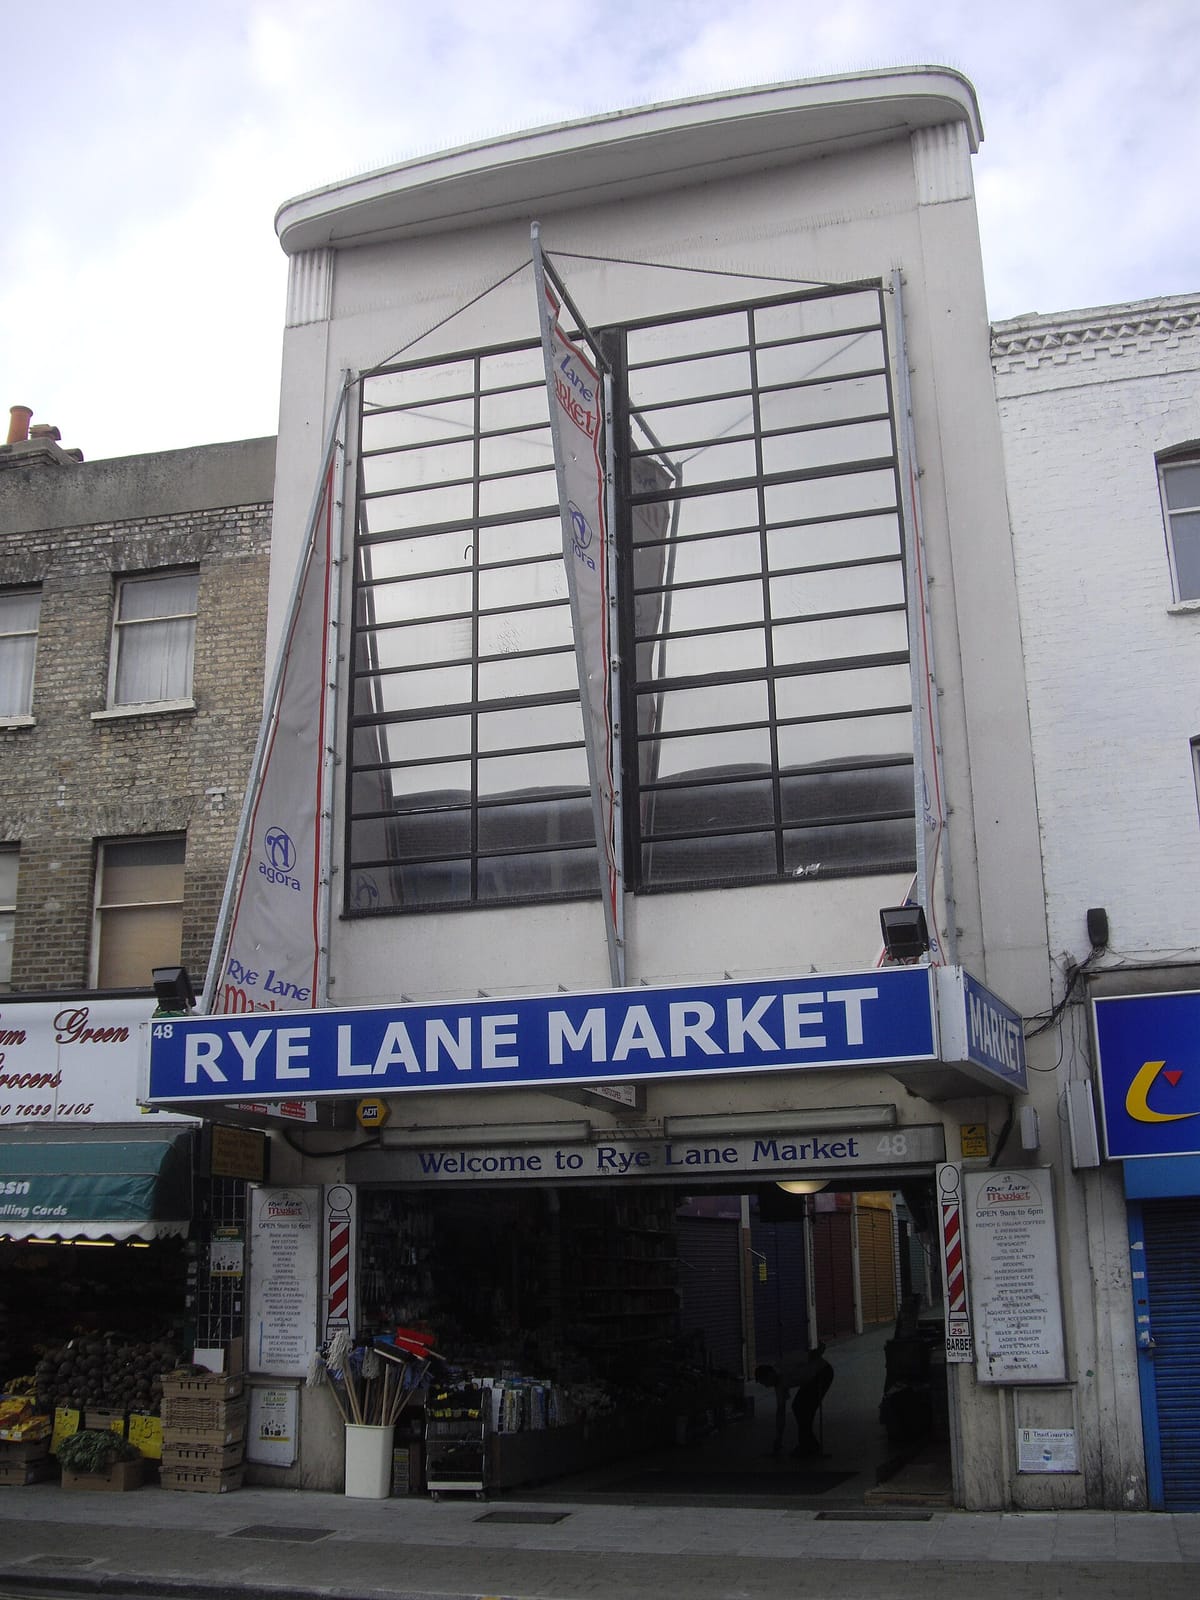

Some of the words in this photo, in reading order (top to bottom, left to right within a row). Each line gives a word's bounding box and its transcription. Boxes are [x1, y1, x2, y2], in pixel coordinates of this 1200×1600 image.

[560, 354, 593, 402] Lane
[259, 862, 301, 891] agora
[227, 958, 259, 985] Rye
[264, 969, 311, 1001] Lane
[53, 1007, 130, 1044] Green
[152, 1024, 174, 1039] 48
[183, 1027, 311, 1084] RYE
[337, 1013, 519, 1077] LANE
[548, 987, 879, 1065] MARKET
[969, 992, 1021, 1073] MARKET
[16, 1103, 52, 1116] 7639
[57, 1103, 94, 1115] 7105
[363, 1107, 378, 1117] ADT
[419, 1151, 542, 1174] Welcome
[555, 1150, 584, 1170] to
[597, 1146, 650, 1173] Rye
[664, 1144, 739, 1166] Lane
[752, 1137, 859, 1162] Market
[876, 1134, 908, 1156] 48
[32, 1204, 68, 1216] Cards
[976, 1209, 997, 1218] OPEN
[1000, 1209, 1016, 1217] 9am
[1028, 1207, 1043, 1217] 6pm
